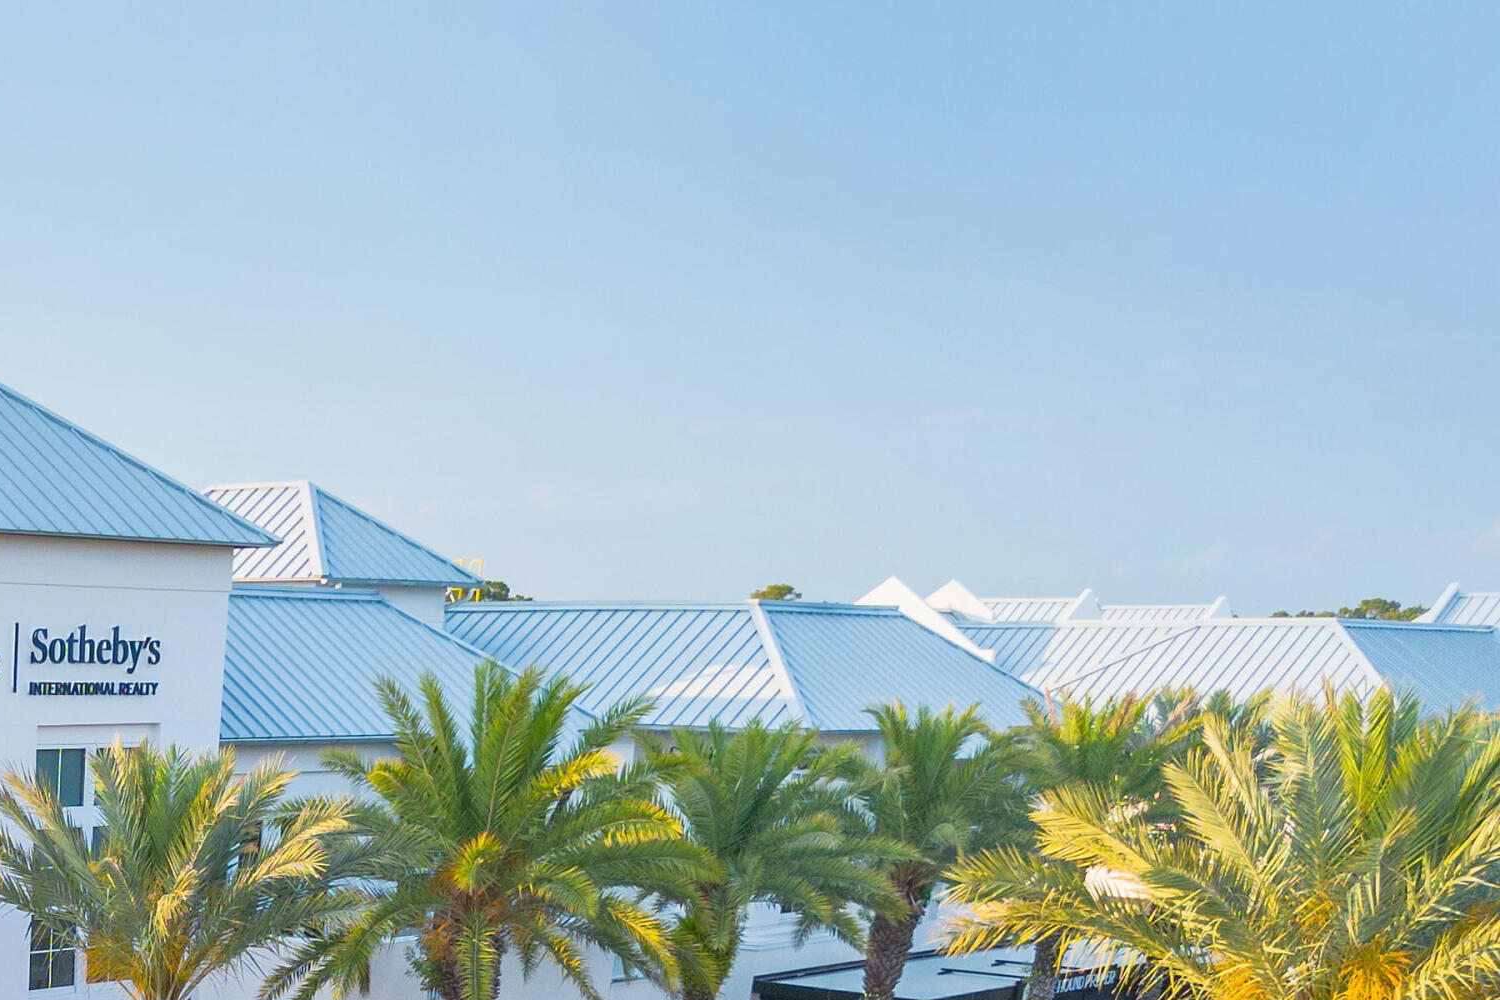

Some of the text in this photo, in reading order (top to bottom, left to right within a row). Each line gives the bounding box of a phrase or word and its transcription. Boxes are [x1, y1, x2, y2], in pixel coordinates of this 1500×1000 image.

[30, 623, 161, 674] Sotheby's
[28, 681, 159, 696] INTERNATIONAL REALTY
